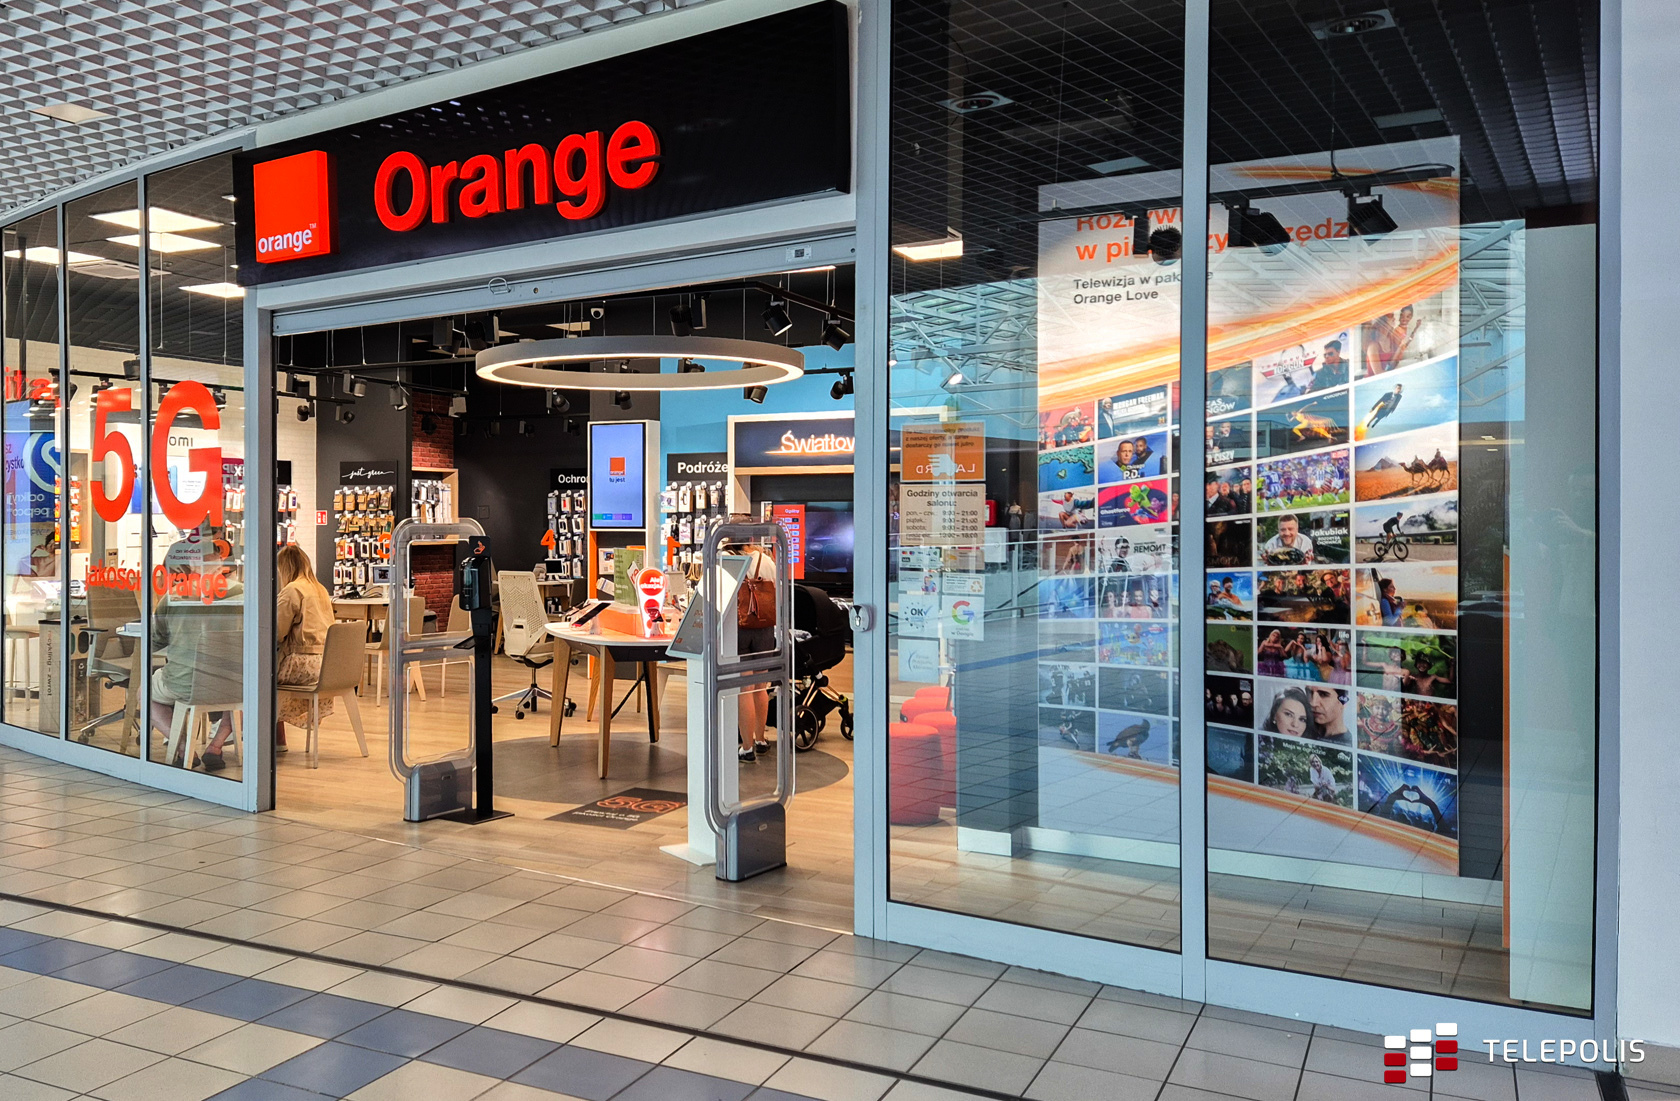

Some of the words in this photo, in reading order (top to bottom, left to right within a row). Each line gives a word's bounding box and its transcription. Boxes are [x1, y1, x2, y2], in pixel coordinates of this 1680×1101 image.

[374, 120, 662, 232] Orange
[258, 228, 312, 253] orange
[1076, 244, 1098, 261] w
[1074, 275, 1135, 289] Telewizja
[1140, 276, 1151, 285] w
[1074, 292, 1122, 304] Orange
[1127, 290, 1158, 301] Love
[1274, 364, 1288, 375] TOP
[1289, 359, 1304, 372] GUN
[90, 380, 223, 529] 5G
[677, 461, 728, 474] Podróże
[1123, 470, 1141, 480] P.D.
[558, 474, 588, 484] Ochro
[907, 489, 939, 499] Godziny
[942, 489, 978, 498] otwarcia
[541, 529, 556, 550] 4
[85, 557, 141, 591] jakości
[152, 565, 228, 605] Orange
[910, 608, 923, 617] OK
